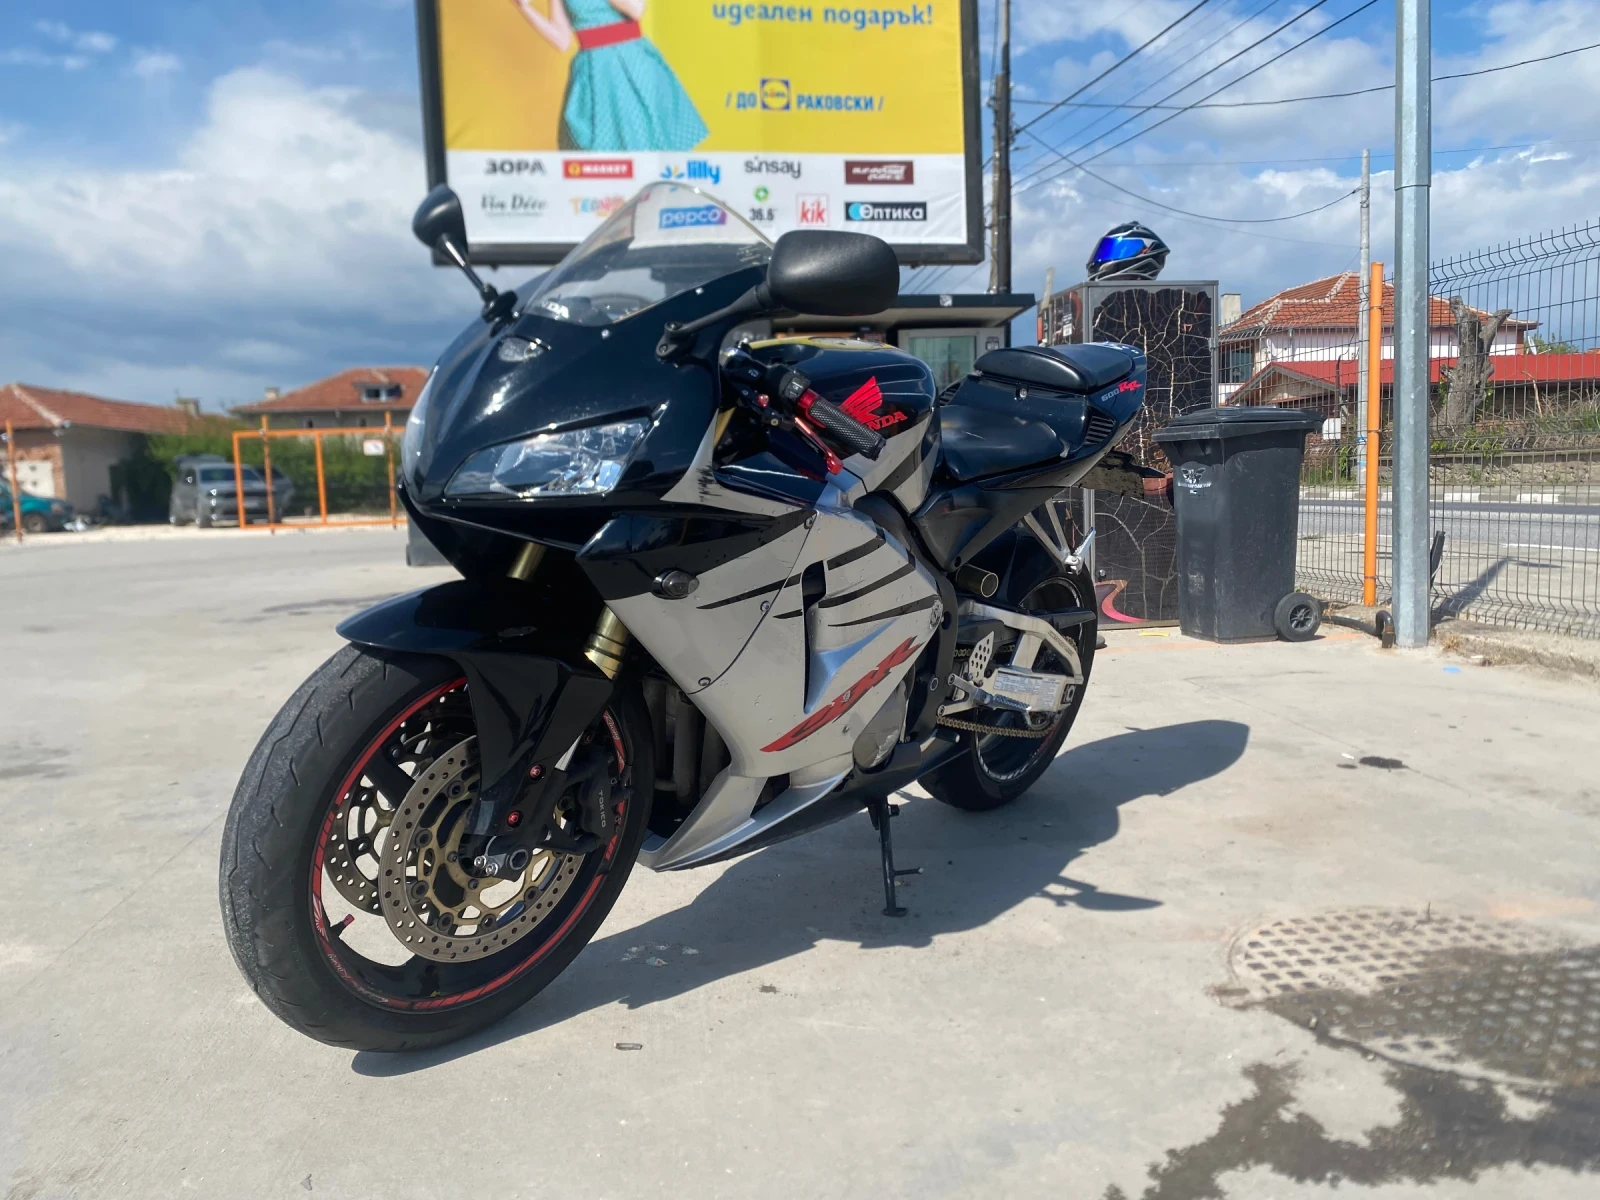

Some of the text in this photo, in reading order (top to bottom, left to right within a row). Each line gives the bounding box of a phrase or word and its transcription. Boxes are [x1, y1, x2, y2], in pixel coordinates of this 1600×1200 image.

[712, 3, 933, 31] идеален подарък!
[796, 94, 874, 111] РАКОВСКИ
[686, 160, 720, 184] lilly
[744, 156, 801, 179] sinsay
[661, 207, 722, 226] pepco
[800, 200, 826, 223] kik
[866, 411, 908, 431] NDA
[598, 789, 607, 828] TOKICO
